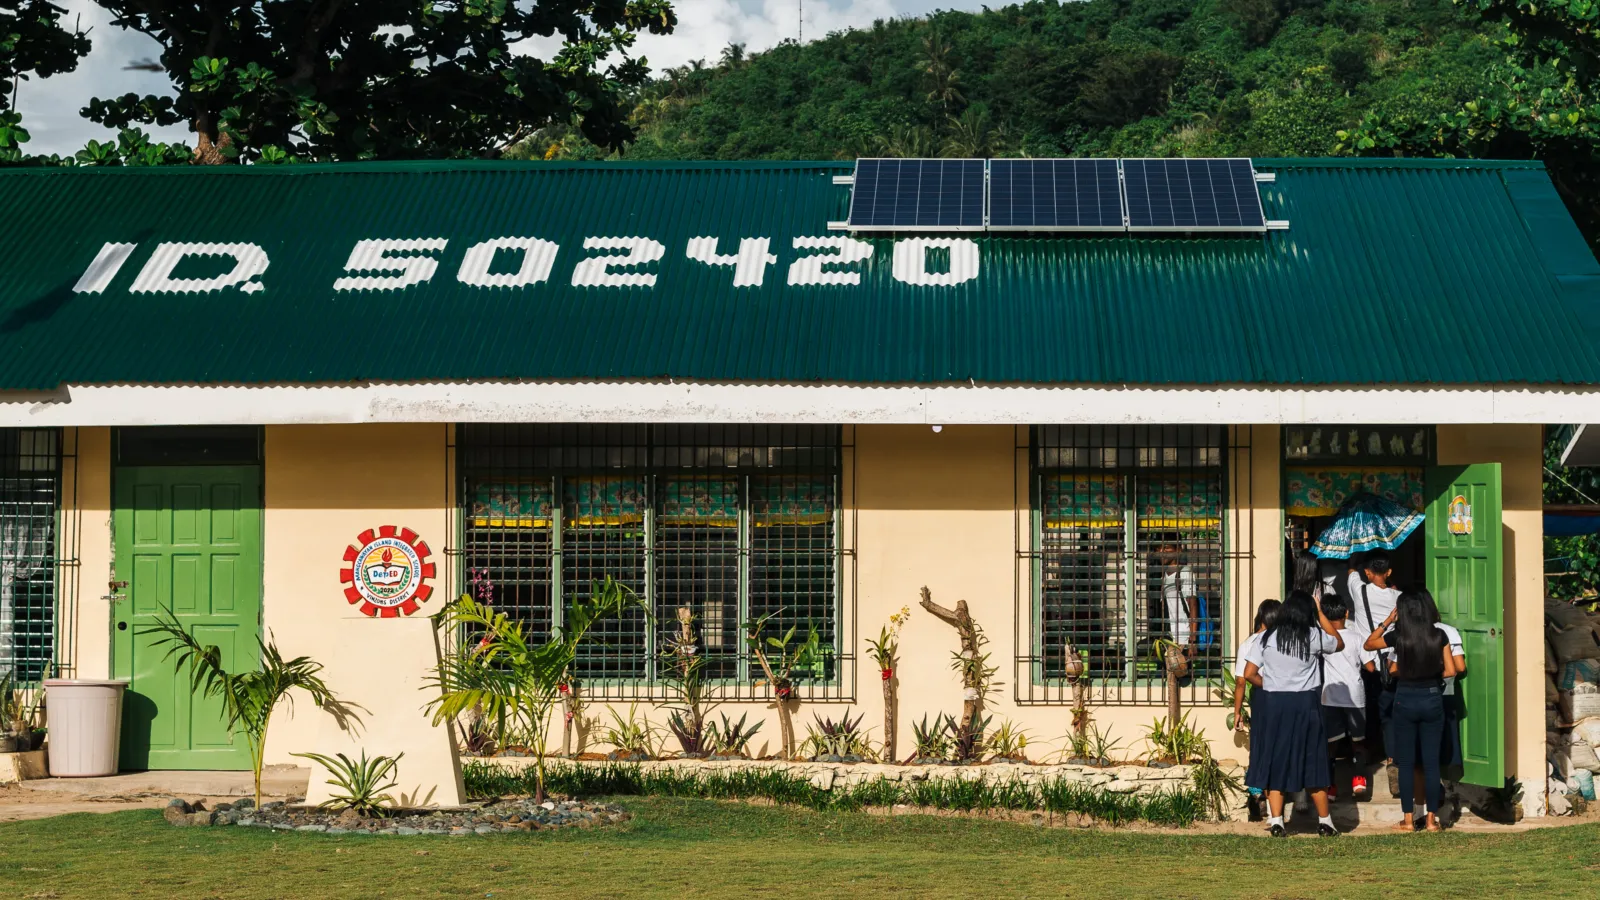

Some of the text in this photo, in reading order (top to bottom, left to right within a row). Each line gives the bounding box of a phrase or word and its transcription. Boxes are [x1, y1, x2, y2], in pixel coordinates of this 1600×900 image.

[333, 236, 979, 291] 502420
[374, 540, 392, 548] ISLAND
[394, 540, 416, 559] INTEGRATED
[373, 570, 398, 578] DepED
[367, 591, 410, 605] VINZONS DISTRICT
